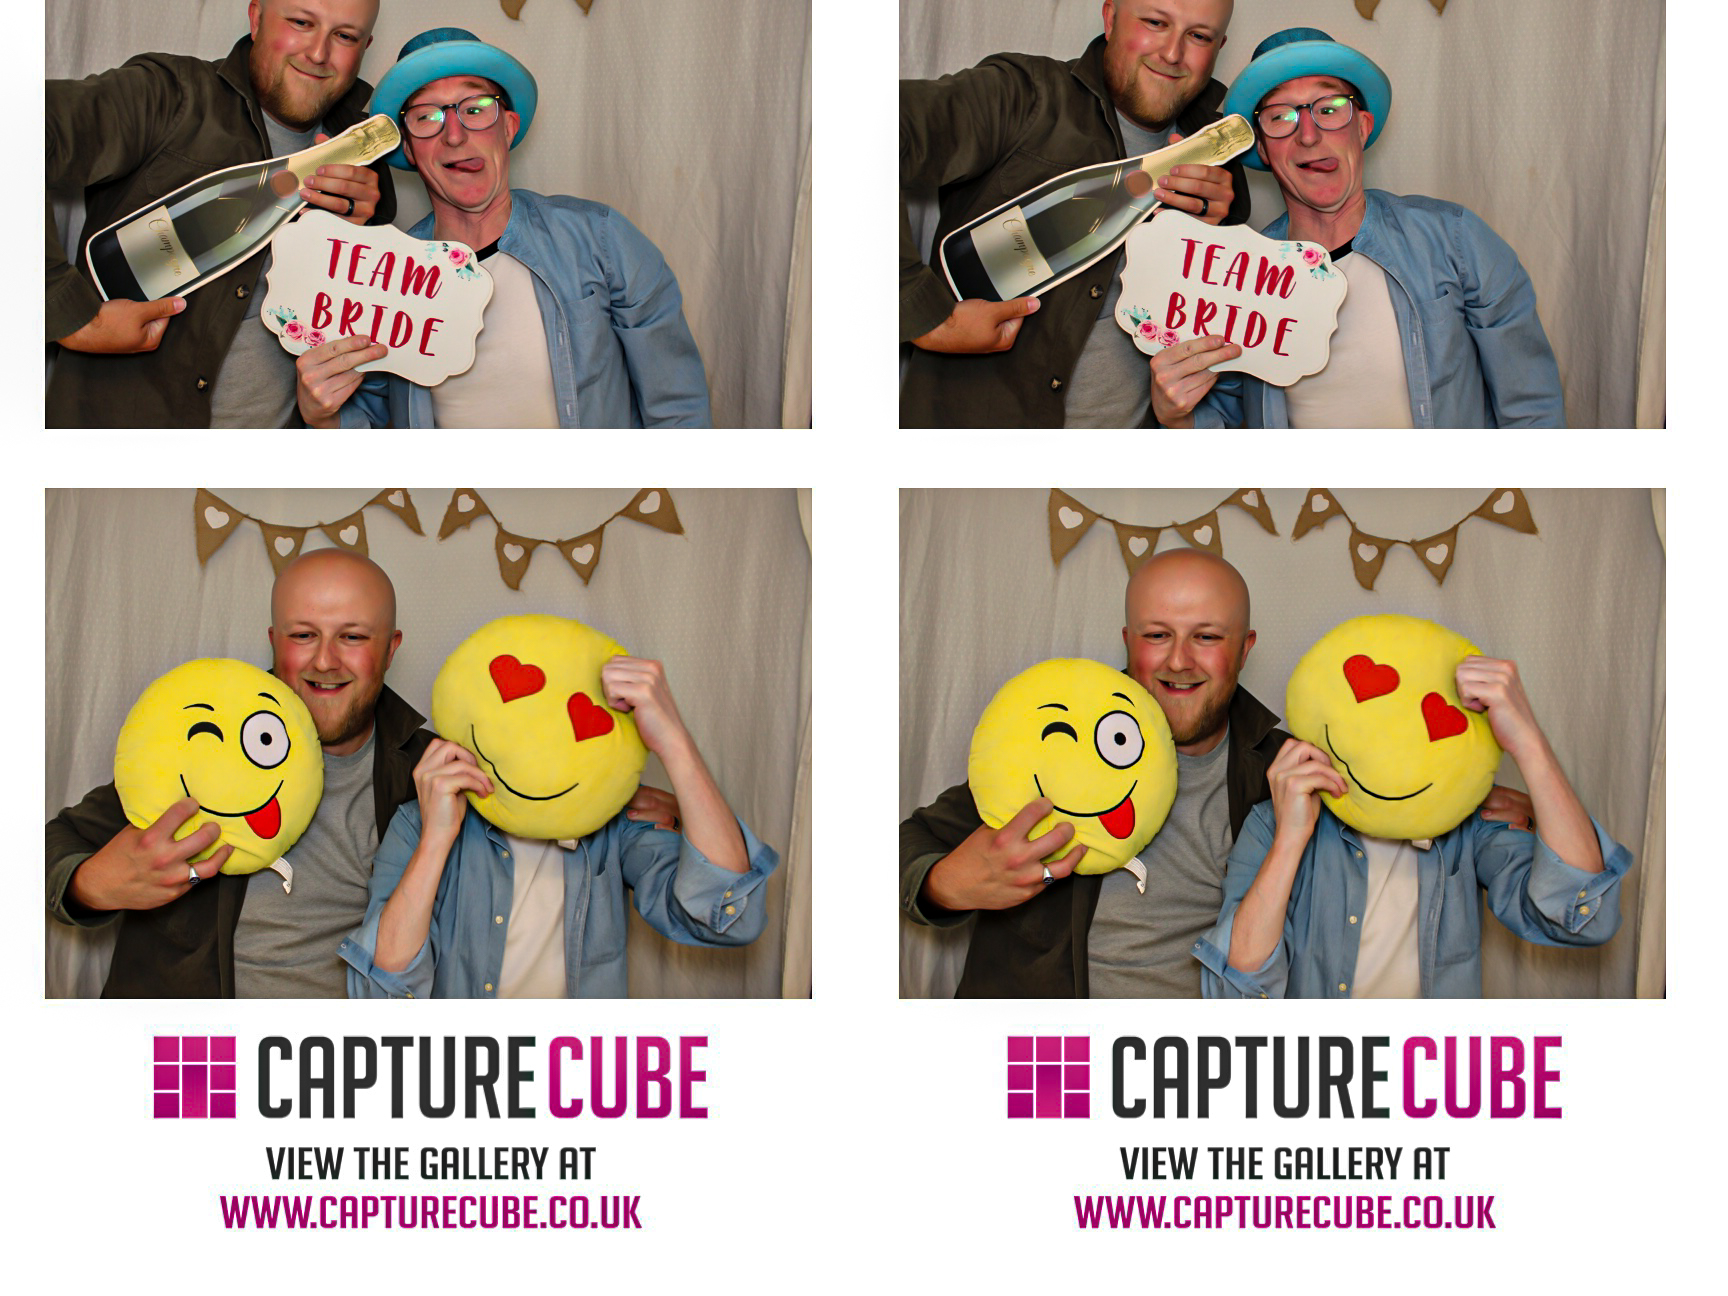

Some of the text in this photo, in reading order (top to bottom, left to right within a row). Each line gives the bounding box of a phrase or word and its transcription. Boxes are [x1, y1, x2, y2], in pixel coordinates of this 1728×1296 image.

[327, 238, 444, 300] TEAM
[1181, 238, 1298, 300] TEAM
[312, 292, 445, 357] BRIDE
[1166, 292, 1299, 357] BRIDE
